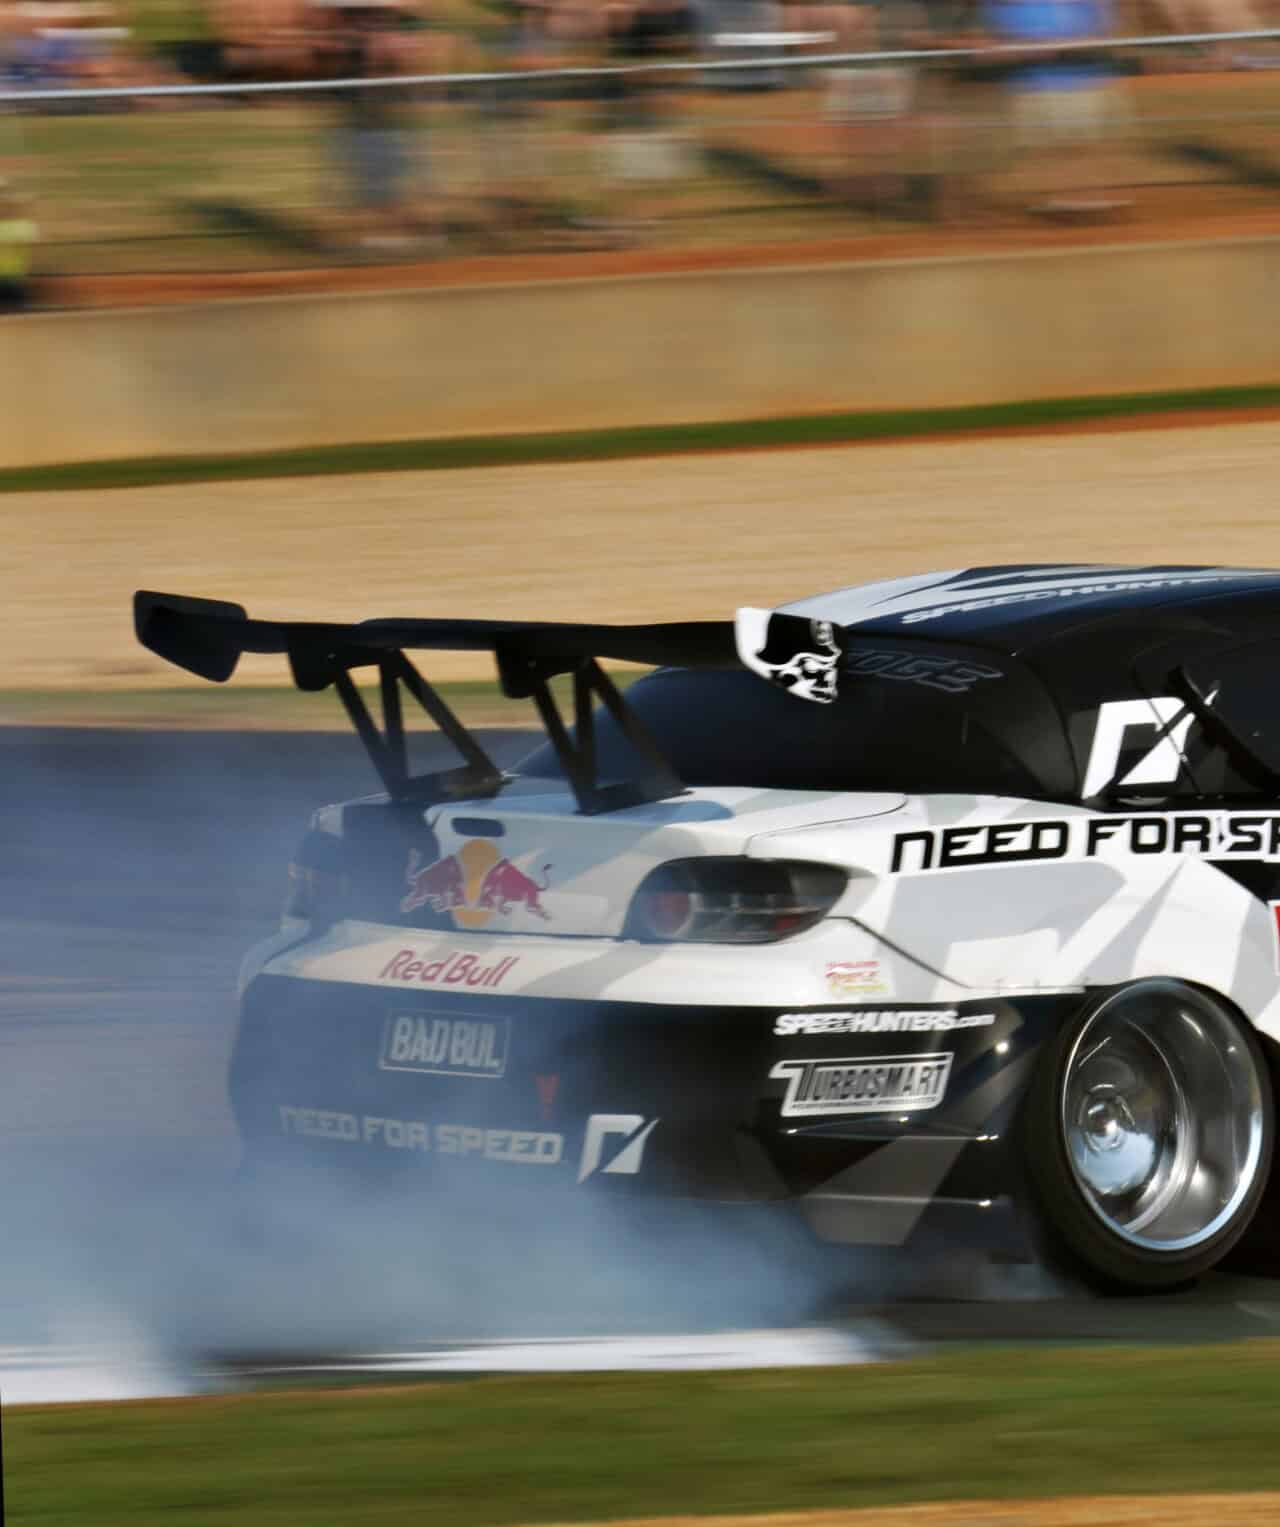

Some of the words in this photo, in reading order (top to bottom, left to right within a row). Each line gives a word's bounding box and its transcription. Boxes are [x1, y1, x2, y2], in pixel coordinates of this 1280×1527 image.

[890, 819, 1069, 874] NEED
[1086, 815, 1213, 858] FOR
[378, 949, 451, 985] Red
[442, 952, 520, 987] Bull
[279, 1105, 359, 1142] NEED
[363, 1114, 430, 1152] FOR
[433, 1123, 564, 1165] SPEED
